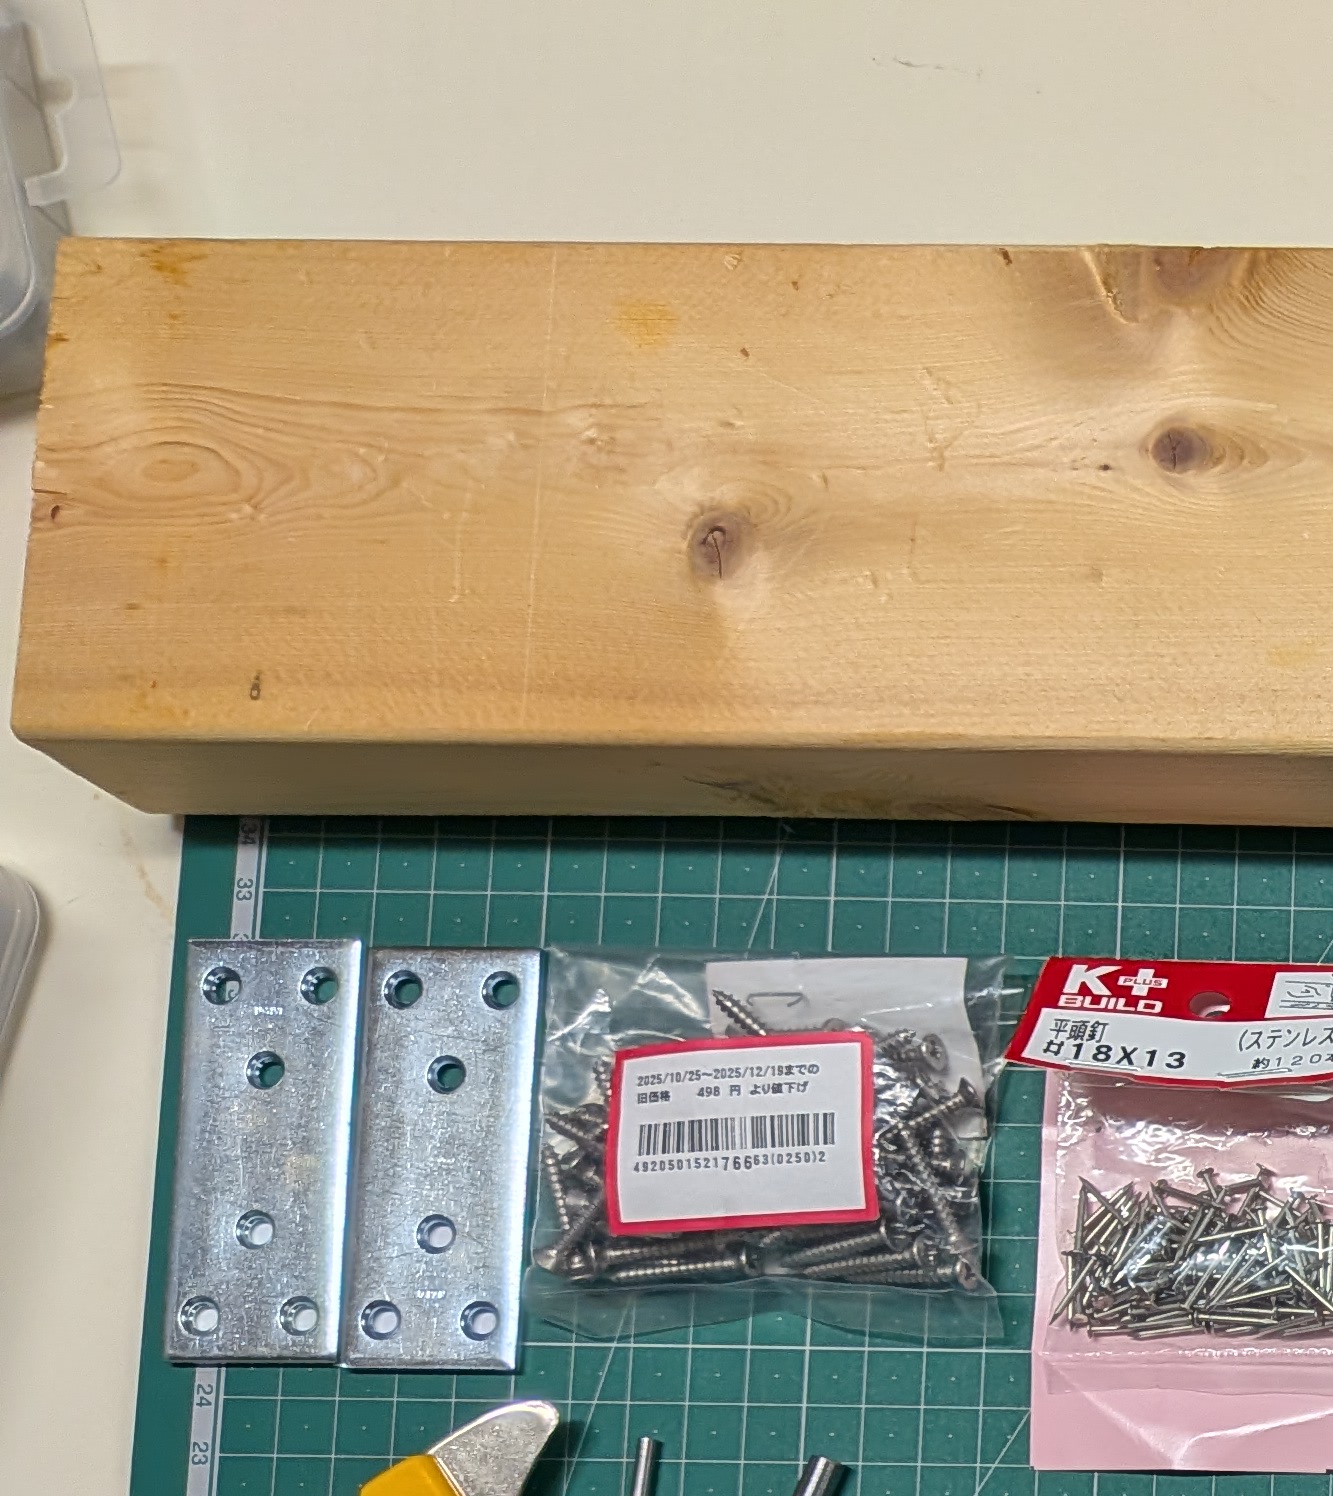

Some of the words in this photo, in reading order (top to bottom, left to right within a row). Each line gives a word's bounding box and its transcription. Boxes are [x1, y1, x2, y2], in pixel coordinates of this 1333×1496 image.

[236, 878, 254, 901] 33
[1063, 964, 1121, 995] K
[1122, 977, 1163, 988] PLUS
[1058, 995, 1163, 1013] BUILD
[1050, 1018, 1109, 1042] 平頭釘
[697, 1086, 721, 1098] 498
[729, 1084, 742, 1096] 円
[750, 1081, 809, 1096] より値下げ
[196, 1383, 214, 1407] 24
[192, 1441, 210, 1465] 23
